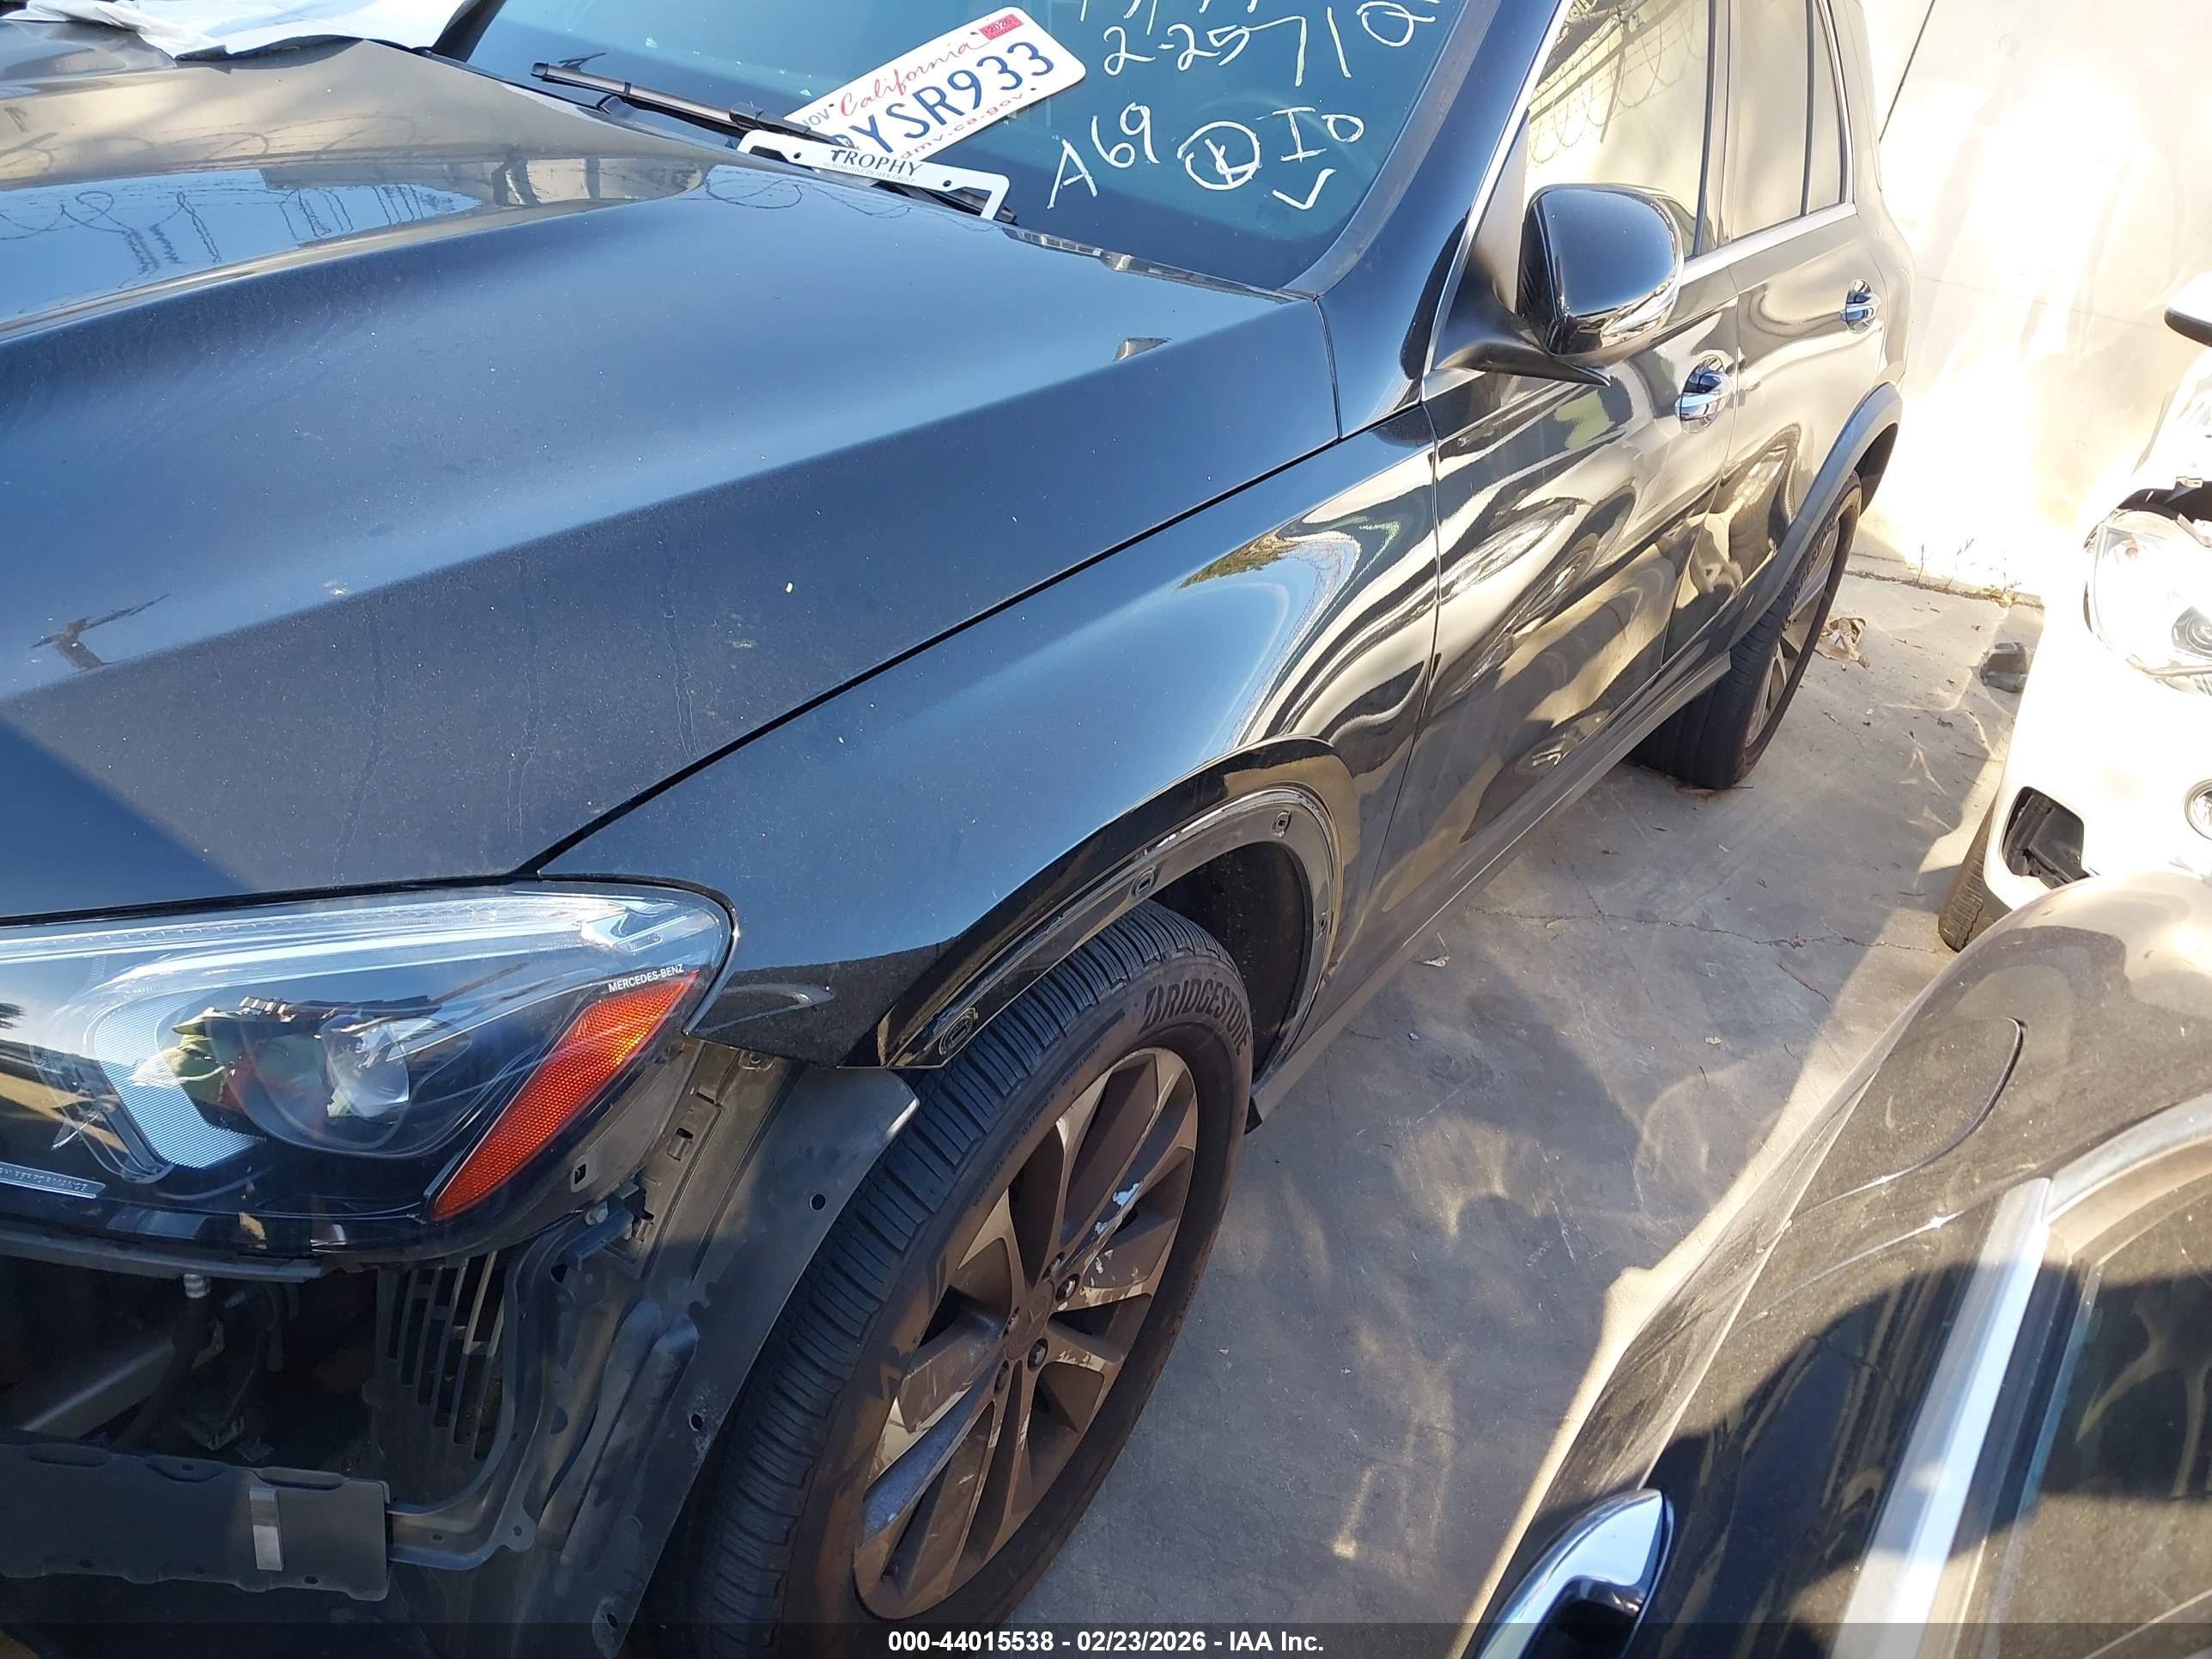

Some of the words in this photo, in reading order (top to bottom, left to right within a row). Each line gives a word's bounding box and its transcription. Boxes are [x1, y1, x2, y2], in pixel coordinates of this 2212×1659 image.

[840, 40, 984, 117] California
[830, 149, 923, 177] TROPHY
[1046, 102, 1161, 210] A69
[608, 963, 684, 993] MERCEDES-BENZ
[1138, 978, 1251, 1056] BRIDGESTONE
